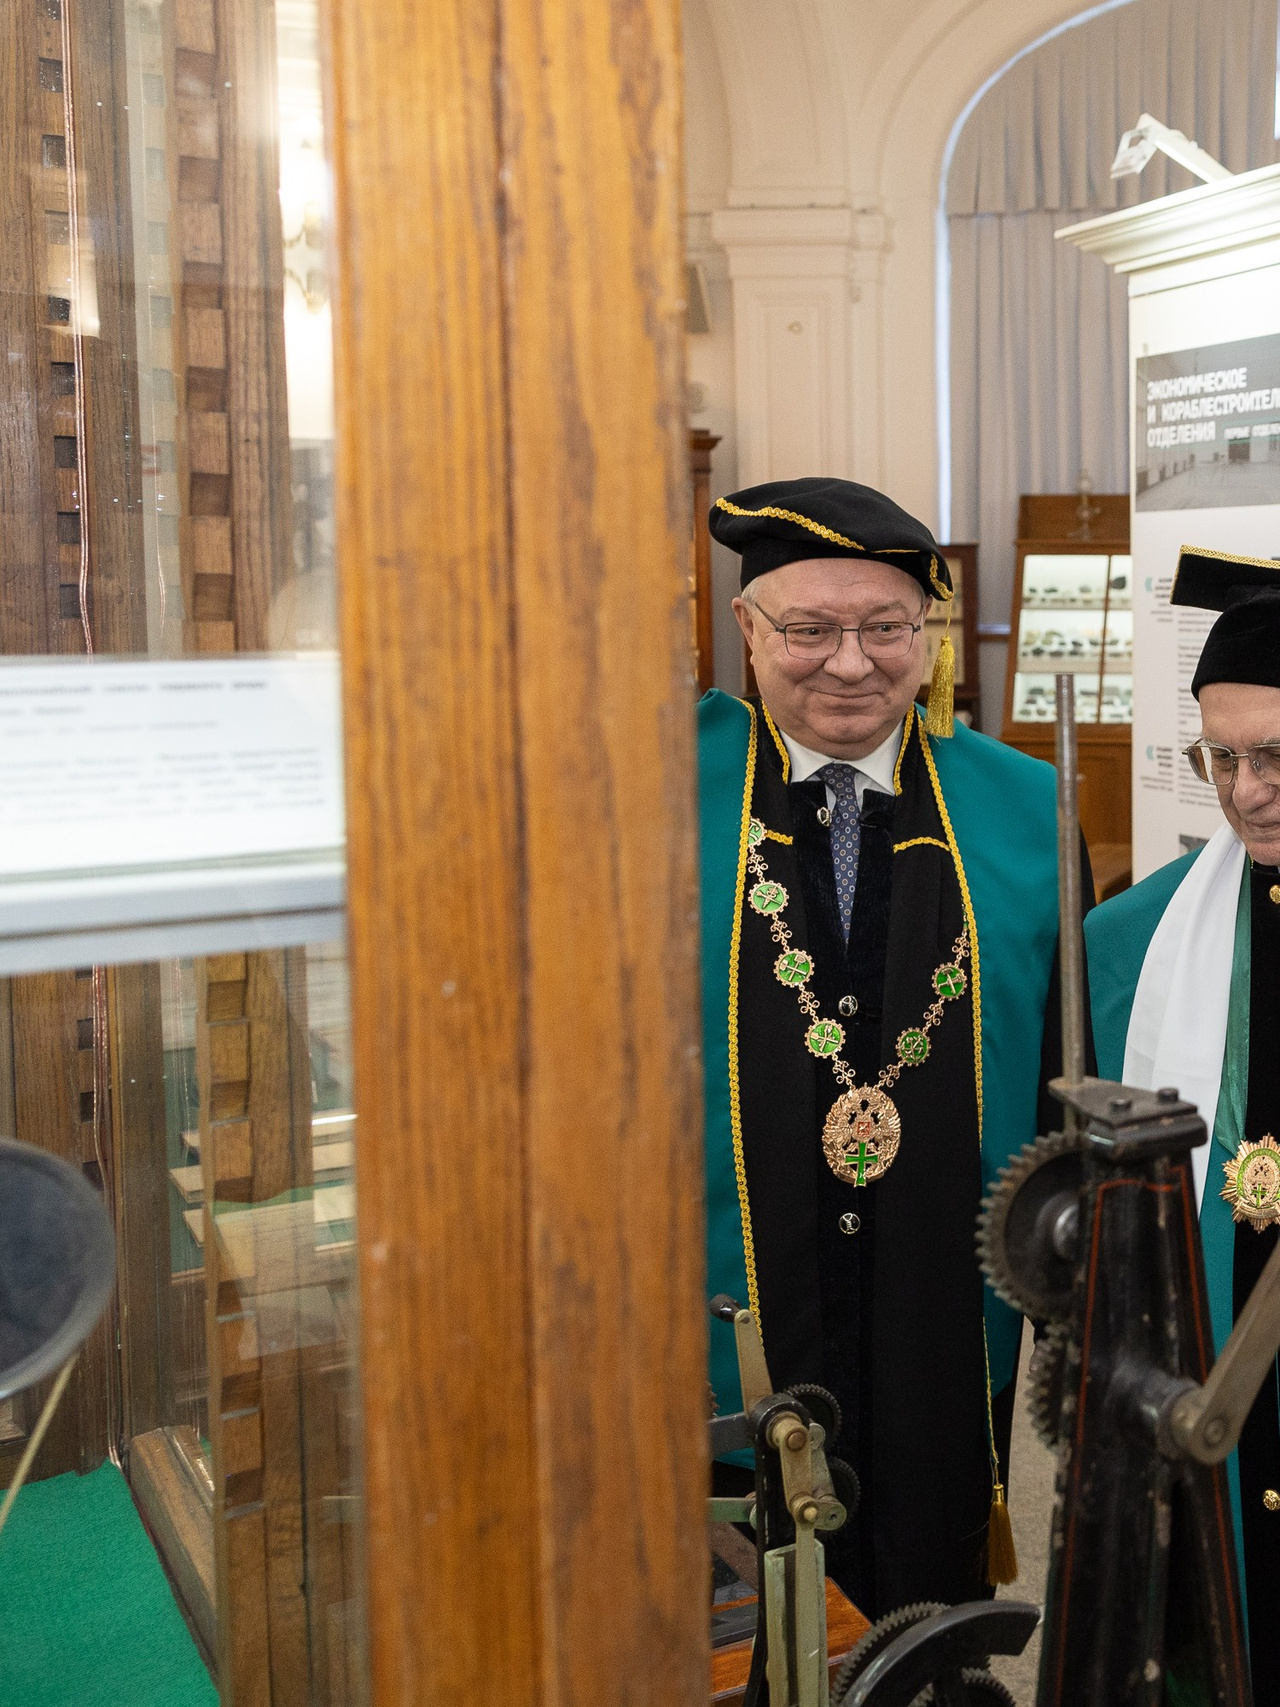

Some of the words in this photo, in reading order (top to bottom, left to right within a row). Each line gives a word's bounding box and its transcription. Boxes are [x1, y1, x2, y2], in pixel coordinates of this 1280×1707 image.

[1147, 367, 1248, 401] ЭКОНОМИЧЕСКОЕ
[1147, 405, 1156, 424] И
[1147, 421, 1216, 449] ОТДЕЛЕНИЯ
